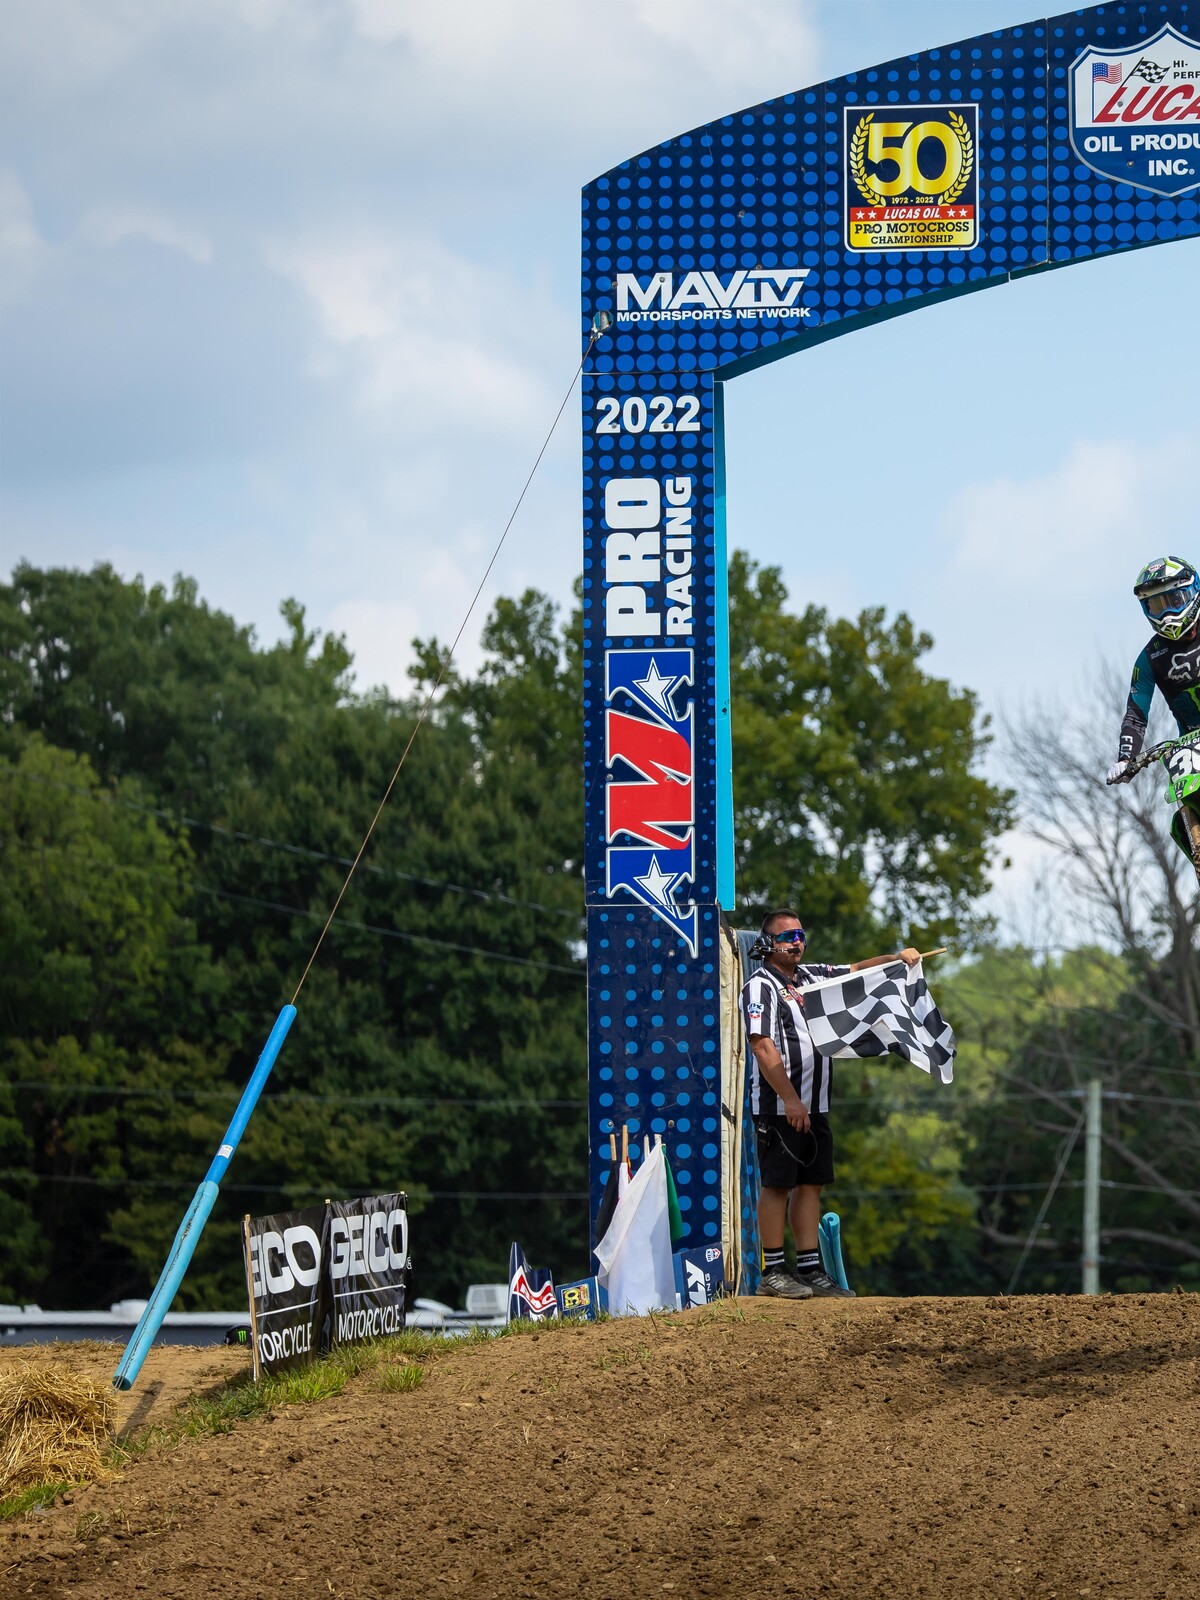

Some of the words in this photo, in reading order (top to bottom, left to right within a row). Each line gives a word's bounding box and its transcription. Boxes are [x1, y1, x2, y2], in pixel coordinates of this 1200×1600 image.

[1173, 60, 1188, 68] HI-
[864, 121, 963, 196] 50
[1084, 136, 1122, 153] OIL
[883, 208, 921, 220] LUCAS
[922, 207, 941, 219] OIL
[891, 197, 908, 205] 1972
[915, 196, 934, 204] 2022
[854, 223, 883, 235] PRO
[886, 221, 970, 234] MOTOCROSS
[870, 235, 954, 245] CHAMPIONSHIP
[616, 309, 733, 322] MOTORSPORTS
[736, 307, 811, 319] NETWORK
[596, 395, 701, 434] 2022
[605, 477, 661, 637] PRO
[665, 476, 693, 636] RACING
[605, 648, 698, 958] AMA
[249, 1224, 322, 1298] EICO
[330, 1209, 409, 1280] GEICO
[685, 1259, 707, 1308] LY
[256, 1322, 313, 1364] TORCYCLE
[338, 1304, 400, 1343] MOTORCYCLE
